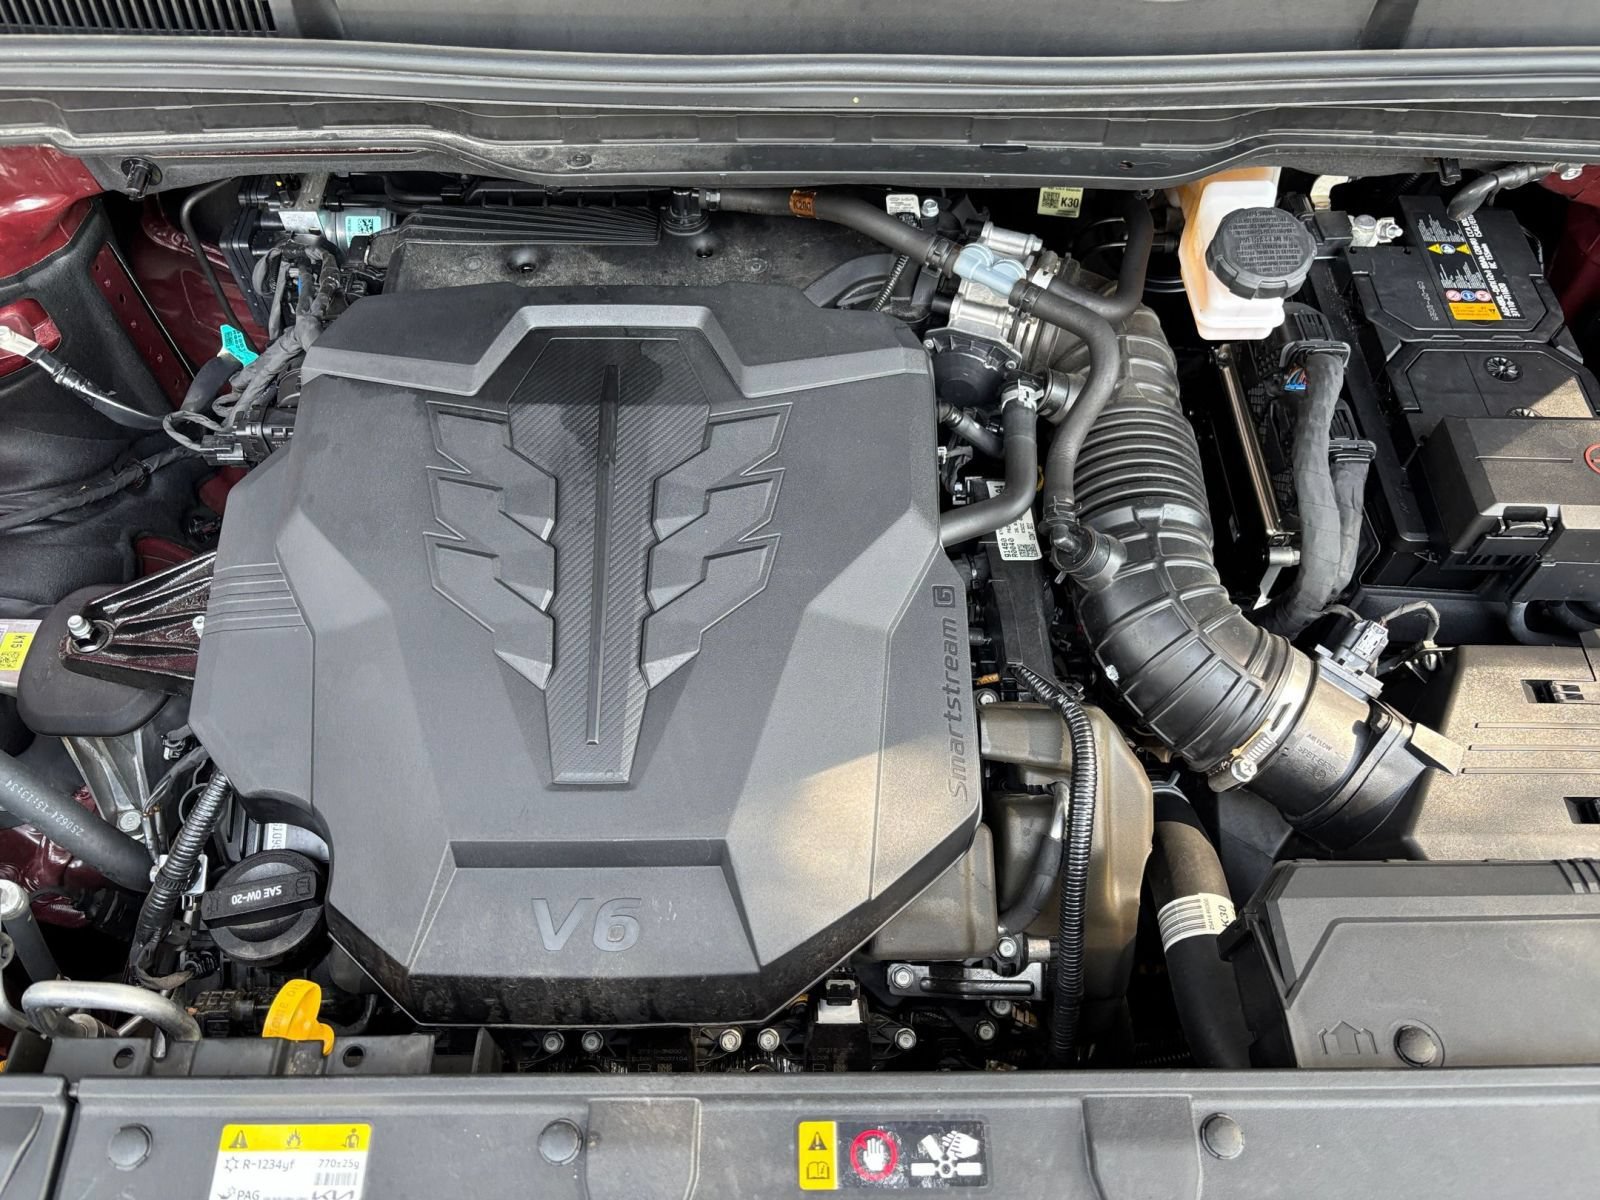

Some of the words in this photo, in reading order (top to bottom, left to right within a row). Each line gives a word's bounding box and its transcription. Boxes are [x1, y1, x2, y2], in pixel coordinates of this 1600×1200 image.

[1060, 197, 1080, 208] K30
[941, 617, 968, 801] Smartstream
[51, 811, 85, 837] 250624
[231, 889, 262, 905] 0W-20
[263, 885, 282, 898] SAE
[531, 898, 642, 952] V6
[242, 1158, 295, 1172] R-1234yf
[237, 1189, 260, 1200] PAG
